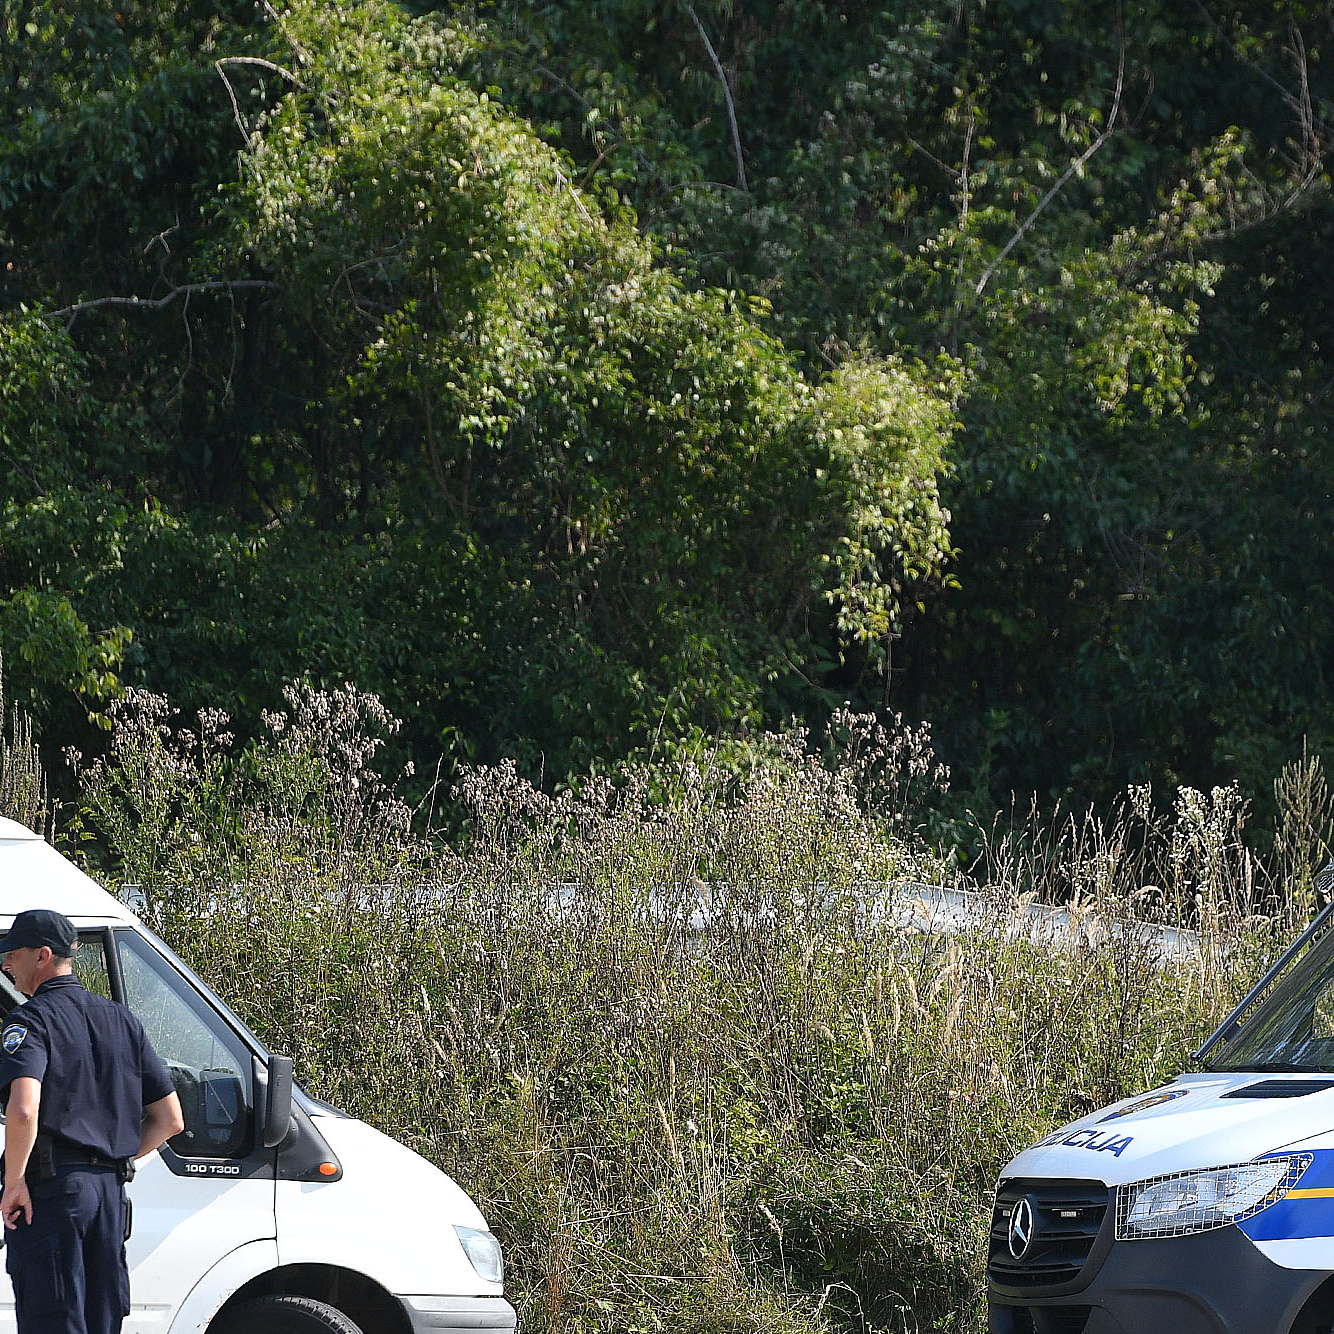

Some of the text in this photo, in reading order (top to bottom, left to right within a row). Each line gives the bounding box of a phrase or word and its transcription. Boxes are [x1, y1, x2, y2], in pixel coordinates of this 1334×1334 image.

[1028, 1129, 1134, 1158] OLICIJA
[185, 1164, 240, 1175] 100 T300
